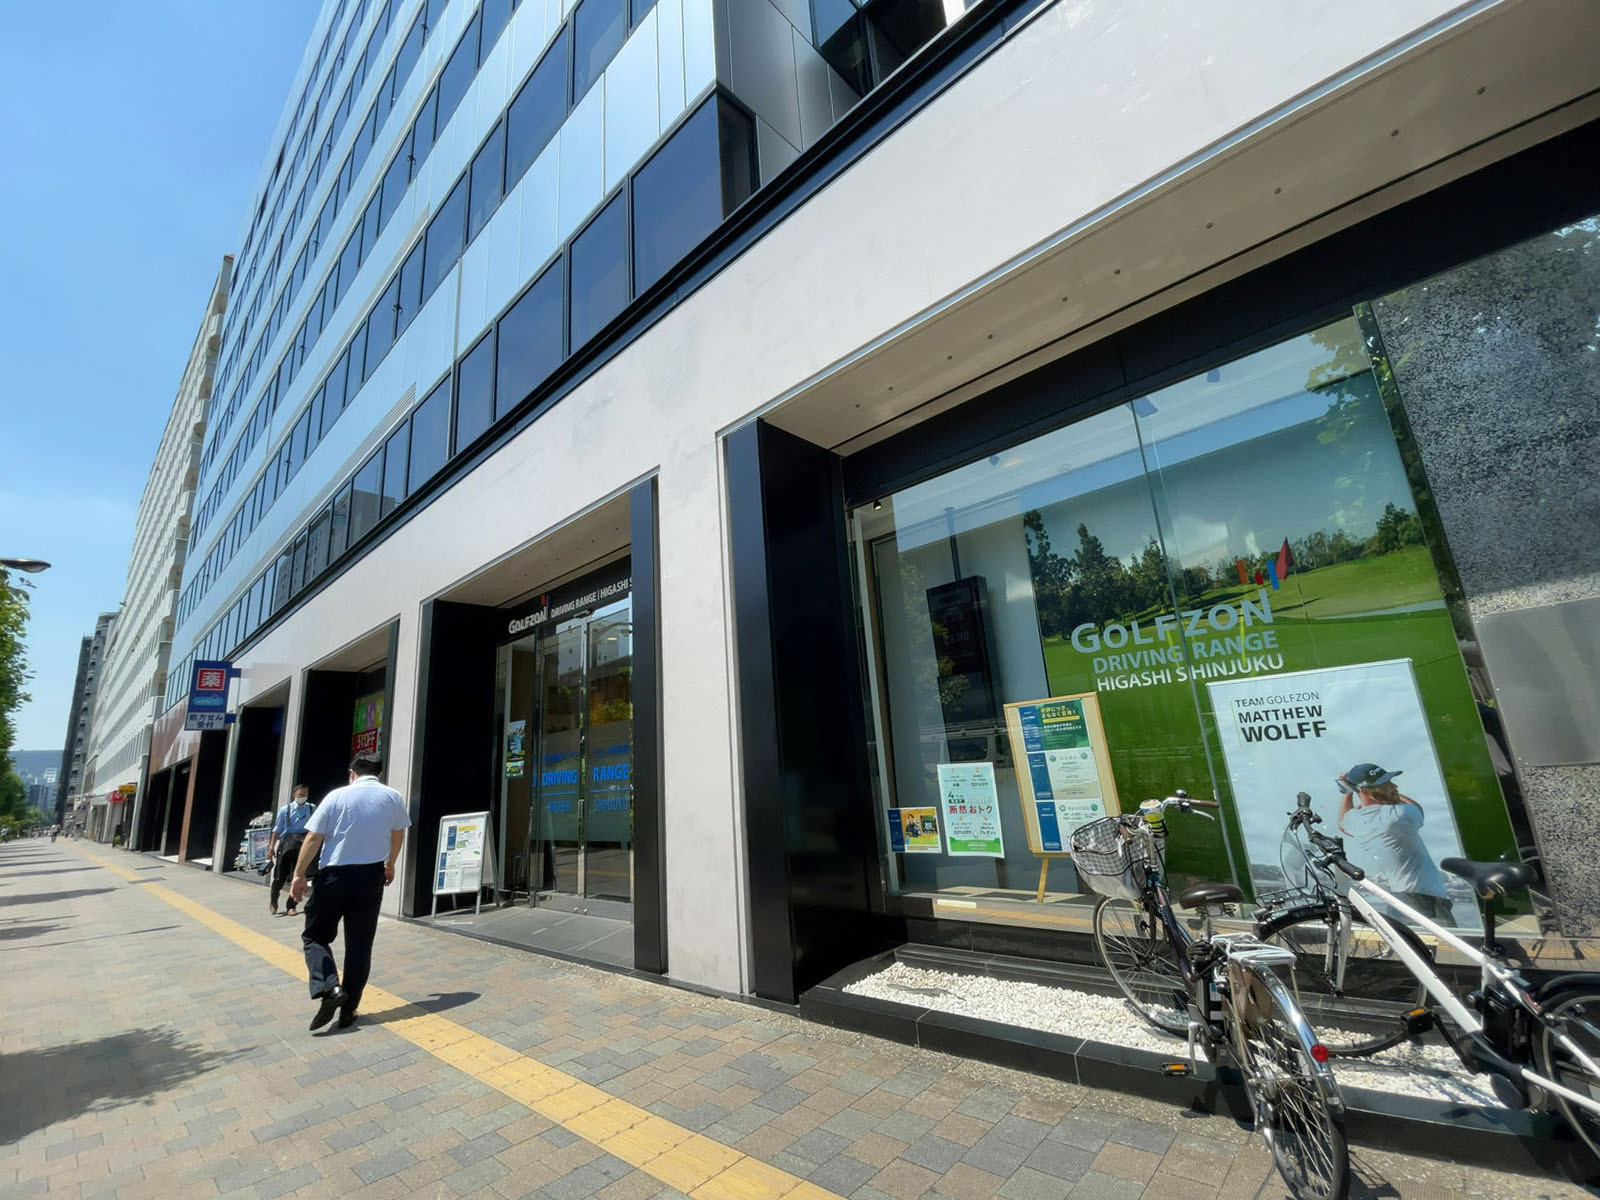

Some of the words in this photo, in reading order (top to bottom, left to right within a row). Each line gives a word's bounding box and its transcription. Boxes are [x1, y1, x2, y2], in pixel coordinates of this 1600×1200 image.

[508, 606, 549, 634] GOLFZON
[550, 601, 576, 618] DRIVING
[575, 591, 597, 609] RANGE
[600, 578, 628, 599] HIGASHI
[1071, 588, 1274, 653] GOLFZON
[1093, 645, 1184, 674] DRIVING
[1192, 630, 1279, 660] RANGE
[1097, 668, 1172, 692] HIGASHI
[1175, 653, 1284, 682] SHINJUKU
[1235, 697, 1264, 708] TEAM
[1266, 691, 1320, 705] GOLFZON
[1238, 705, 1322, 724] MATTHEW
[1241, 720, 1327, 743] WOLFF
[541, 769, 577, 787] DRIVING
[593, 763, 630, 781] RANGE
[948, 805, 993, 815] 断然おトク
